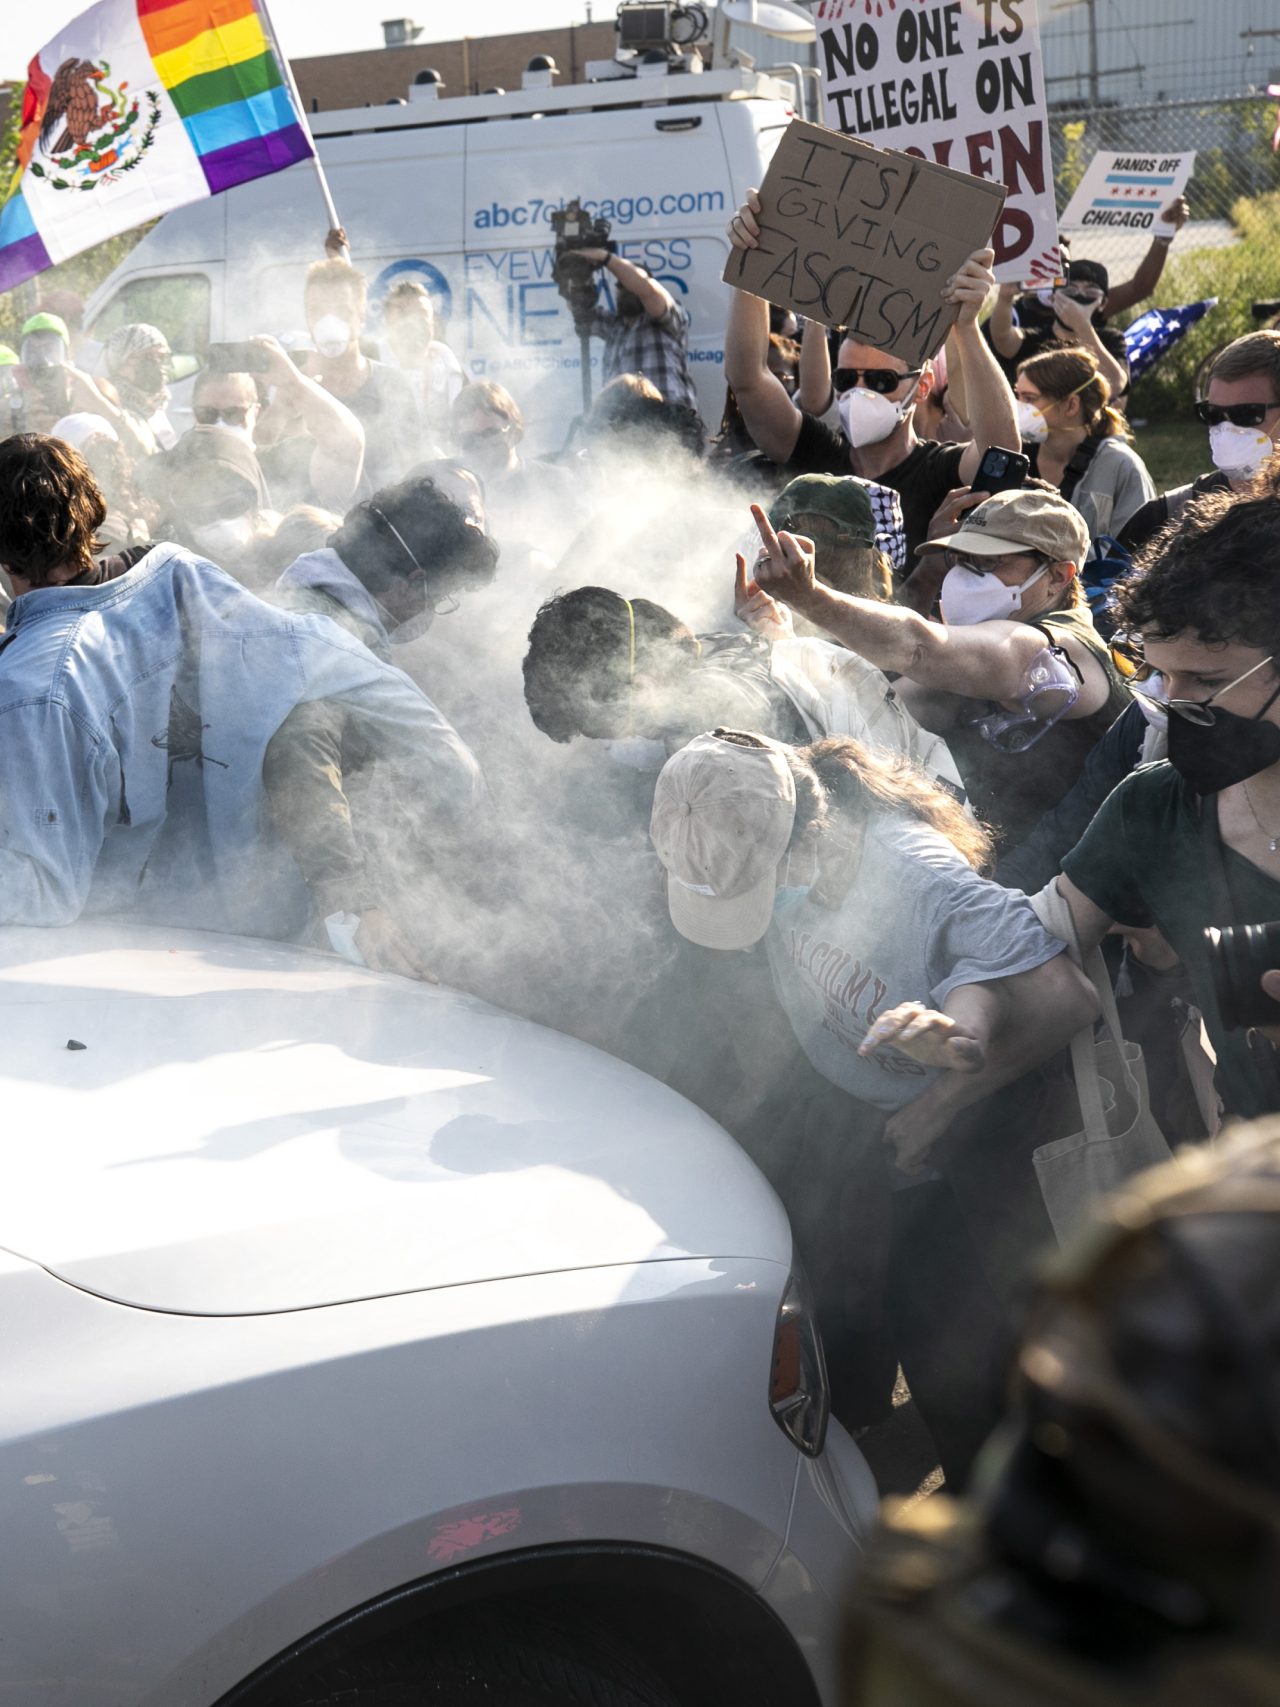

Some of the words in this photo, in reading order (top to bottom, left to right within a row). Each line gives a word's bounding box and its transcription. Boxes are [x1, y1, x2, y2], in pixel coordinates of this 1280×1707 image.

[820, 22, 879, 82] NO
[897, 2, 964, 63] ONE
[977, 0, 1024, 49] IS
[827, 67, 957, 135] ILLEGAL
[976, 52, 1036, 114] ON
[1112, 158, 1157, 172] HANDS
[1158, 159, 1182, 173] OFF
[463, 238, 693, 282] EYEWESS
[776, 187, 941, 272] GIVING
[1081, 210, 1154, 229] CHICAGO
[738, 223, 946, 364] FASCISM
